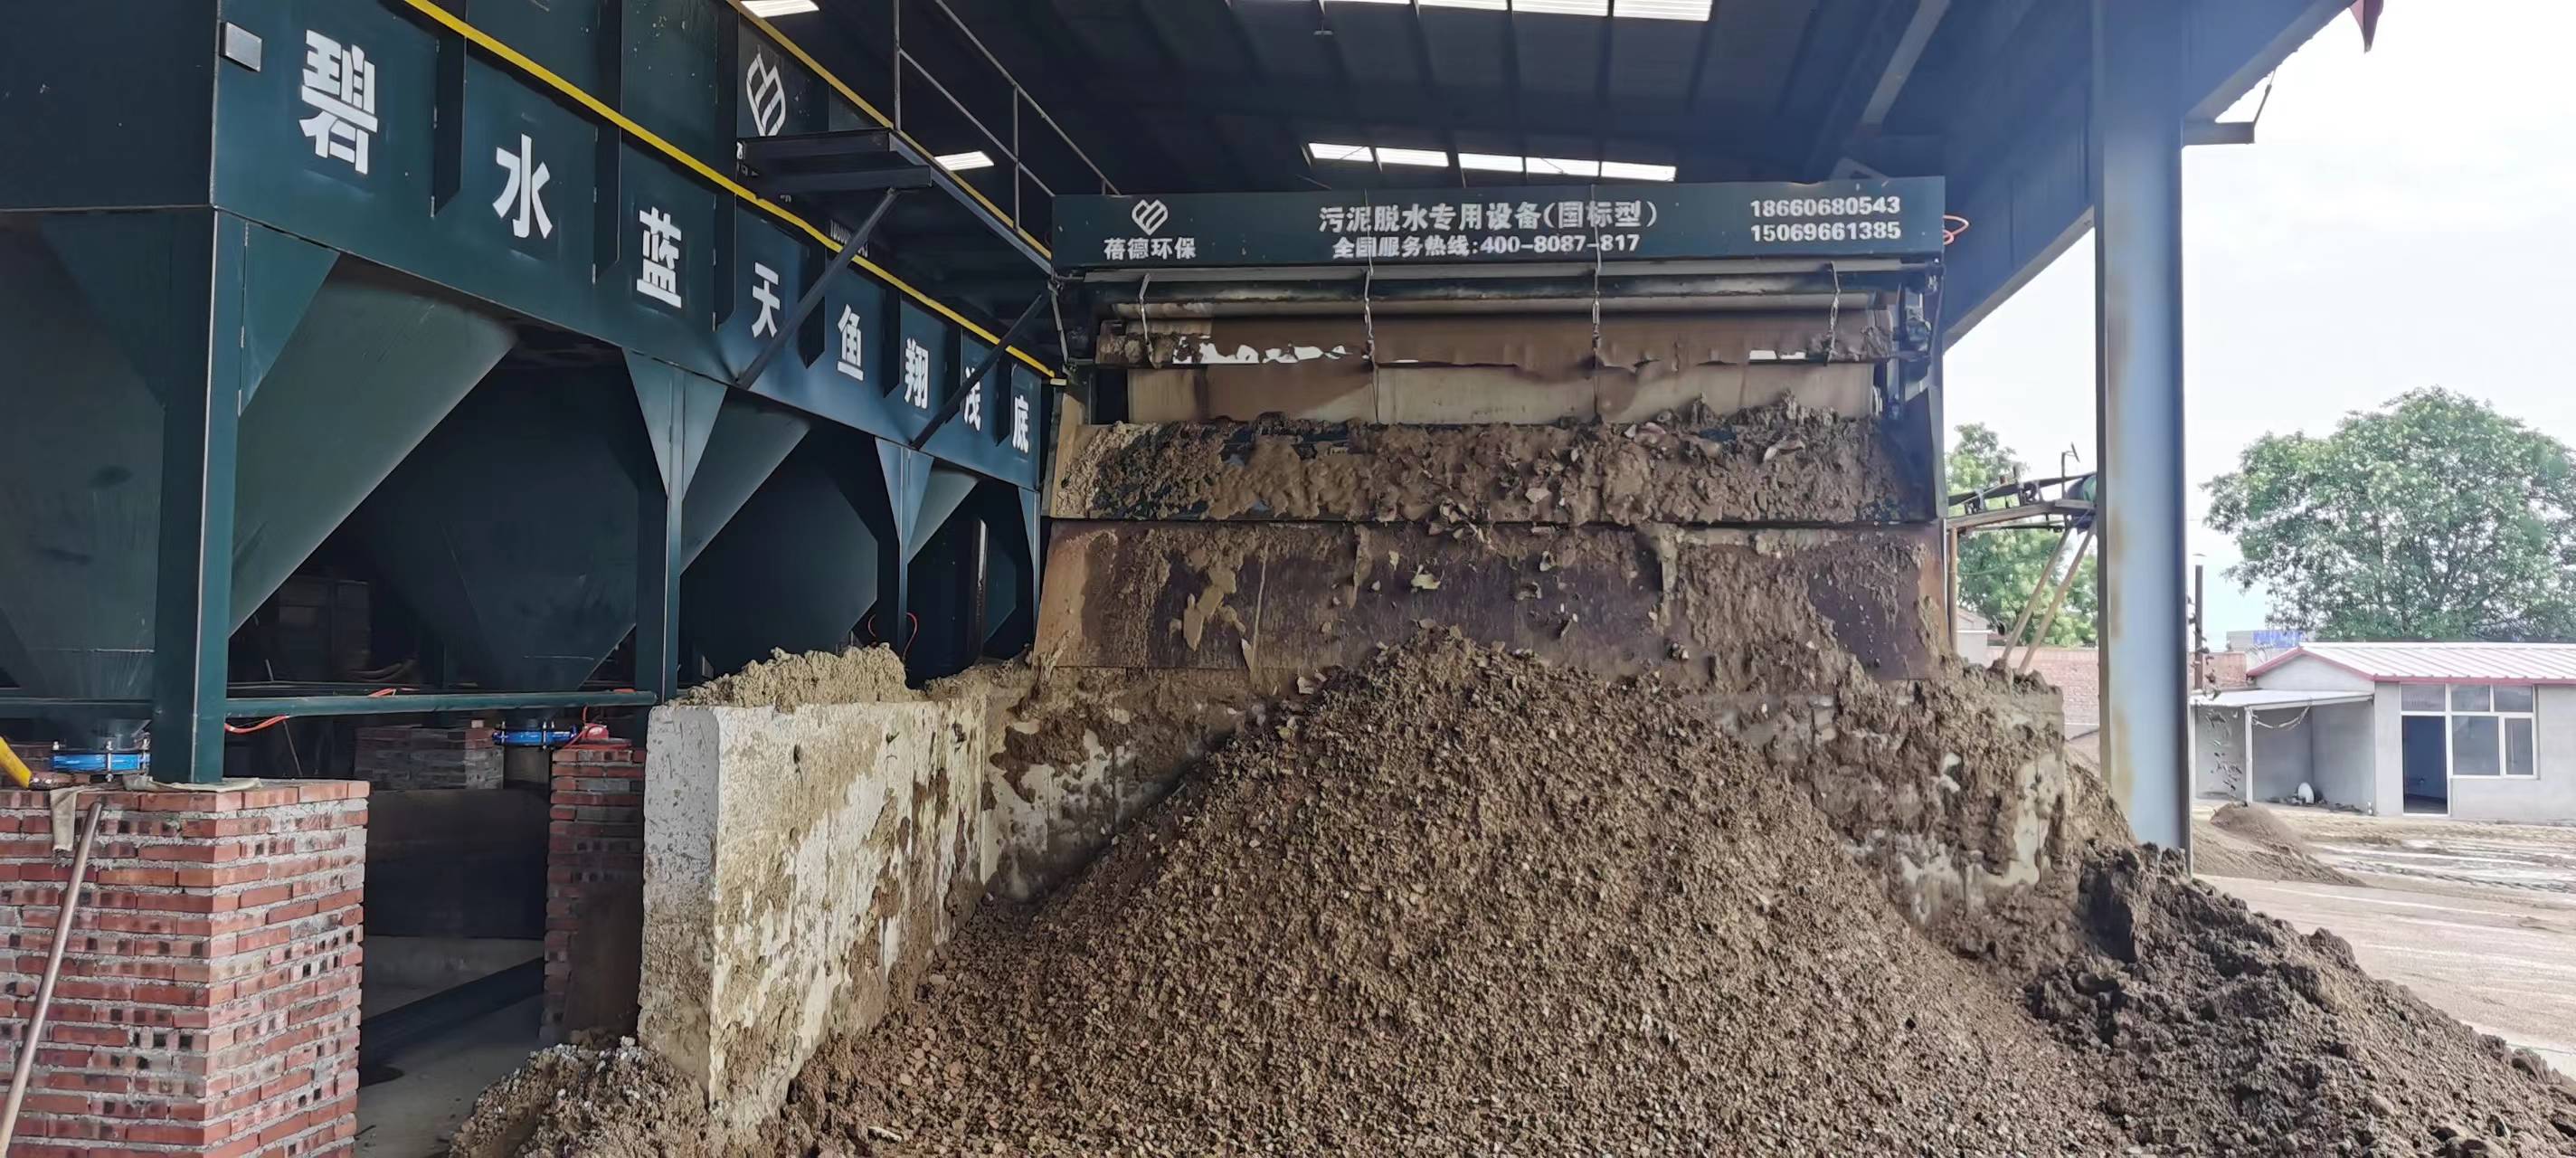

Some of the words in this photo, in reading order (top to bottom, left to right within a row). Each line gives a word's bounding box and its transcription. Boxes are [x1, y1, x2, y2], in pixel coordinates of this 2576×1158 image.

[1319, 200, 1658, 233] 污泥脱水专用设备(国标型)
[1750, 195, 1900, 218] 18660680543
[1751, 221, 1901, 242] 15069661385
[1103, 237, 1197, 261] 蓓德环保
